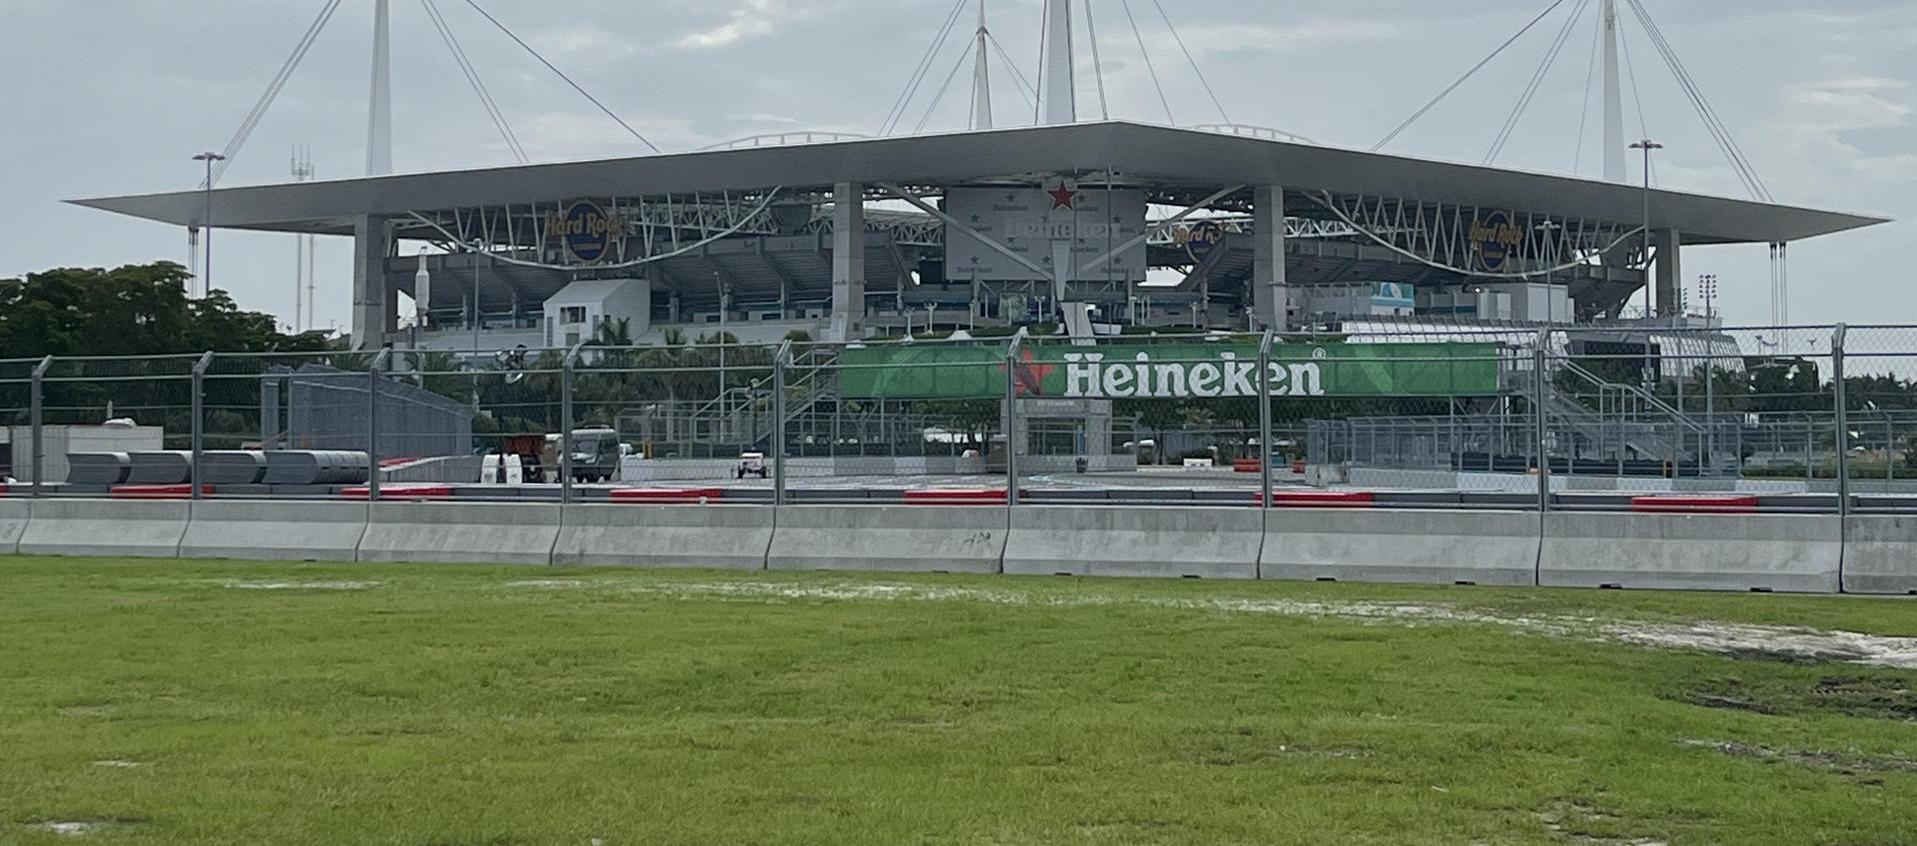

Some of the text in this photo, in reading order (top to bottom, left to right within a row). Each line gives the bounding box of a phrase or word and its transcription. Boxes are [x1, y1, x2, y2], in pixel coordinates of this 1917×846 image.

[544, 211, 625, 239] Hard Rock
[1470, 220, 1524, 249] Hard Rock
[1064, 352, 1325, 398] Heineken
